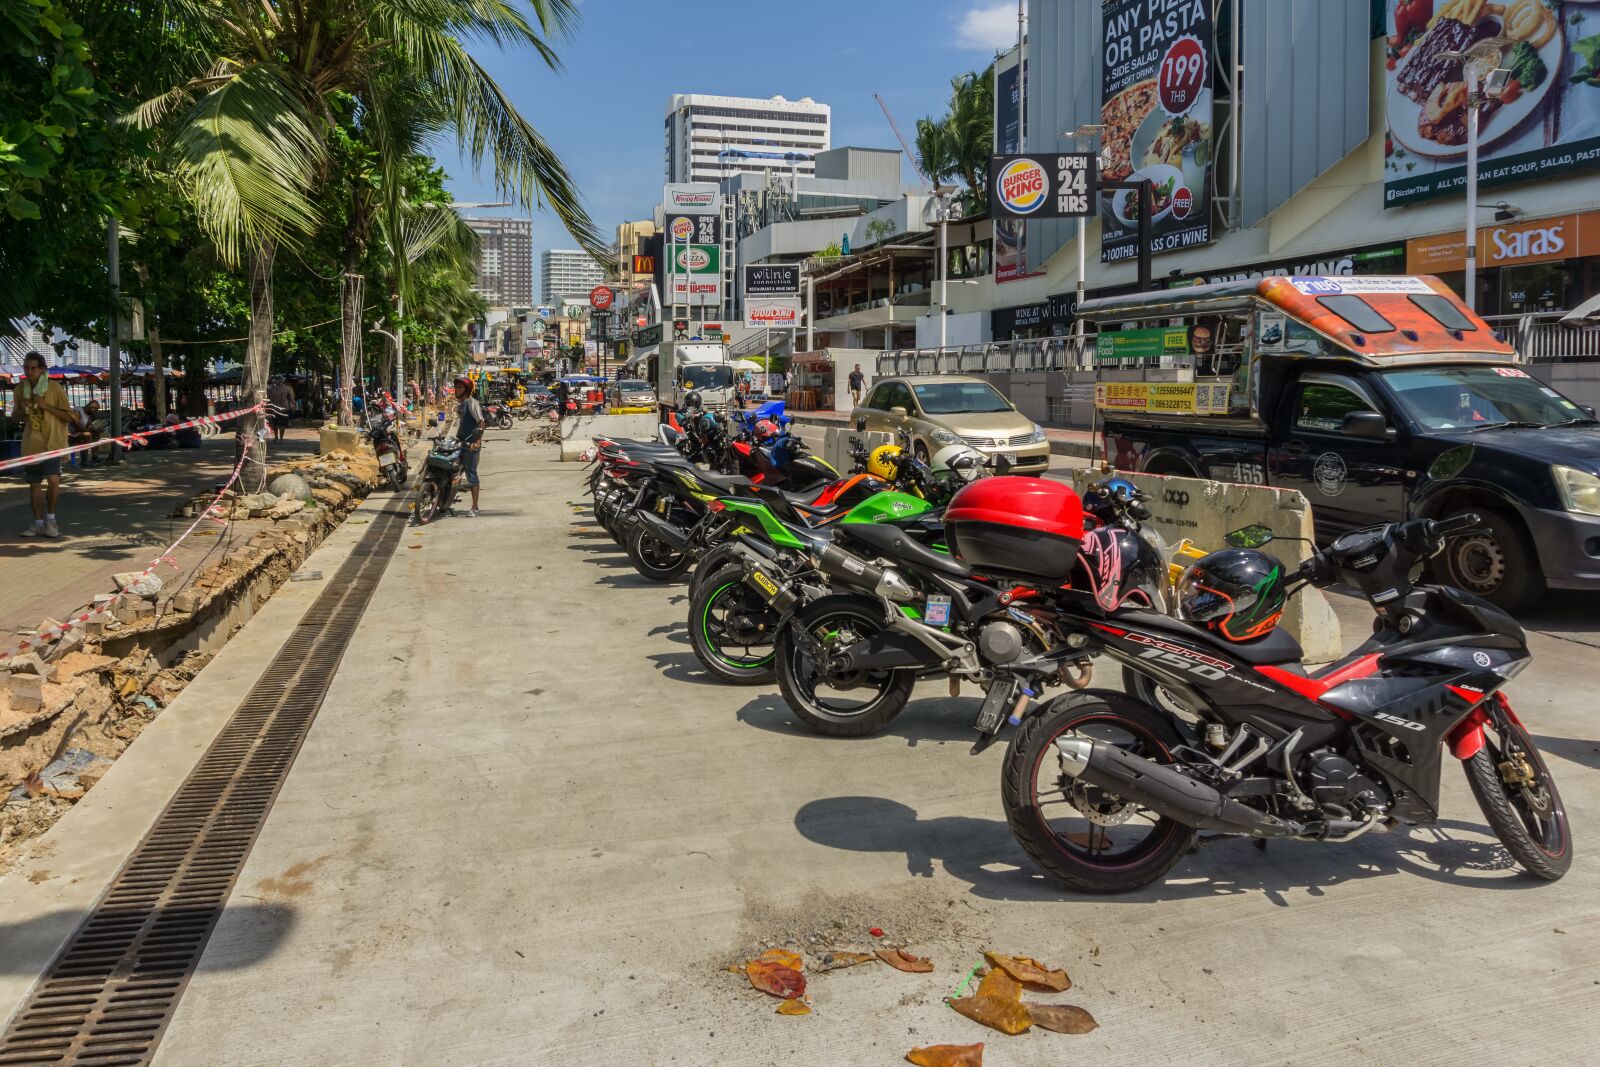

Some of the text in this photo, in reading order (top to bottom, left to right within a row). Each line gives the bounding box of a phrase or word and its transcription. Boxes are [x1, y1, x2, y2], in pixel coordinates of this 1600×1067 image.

[1105, 3, 1142, 43] ANY
[1105, 0, 1206, 67] OR PASTA
[1112, 62, 1130, 80] SIDE
[1131, 49, 1159, 71] SALAD
[1166, 53, 1201, 88] 199
[1109, 80, 1121, 93] ANY
[1121, 75, 1136, 87] SOFT
[1136, 65, 1154, 80] DRINK
[1170, 90, 1186, 103] THB
[1057, 156, 1087, 169] OPEN
[1437, 180, 1452, 190] ALL
[1493, 167, 1509, 178] EAT
[1511, 162, 1538, 175] SOUP,
[1540, 155, 1574, 169] SALAD,
[1003, 168, 1041, 189] BURGER
[1057, 169, 1087, 195] 24
[1005, 177, 1043, 203] KING
[1057, 195, 1088, 213] HRS
[1173, 197, 1191, 208] FREE!
[698, 234, 715, 244] HRS
[699, 222, 714, 235] 24
[1166, 236, 1180, 249] OF
[1182, 229, 1208, 245] WINE
[1492, 225, 1565, 260] Saras
[751, 308, 792, 318] FOODLAND
[1015, 308, 1031, 318] WINE
[1032, 306, 1040, 317] AT
[1097, 335, 1114, 346] Grab
[1097, 345, 1114, 356] Food
[1168, 335, 1184, 345] FREE
[1232, 461, 1264, 485] 455
[756, 574, 779, 593] ARROW
[1124, 632, 1236, 671] EXCITER
[1138, 647, 1228, 681] 150
[1373, 711, 1427, 732] 150
